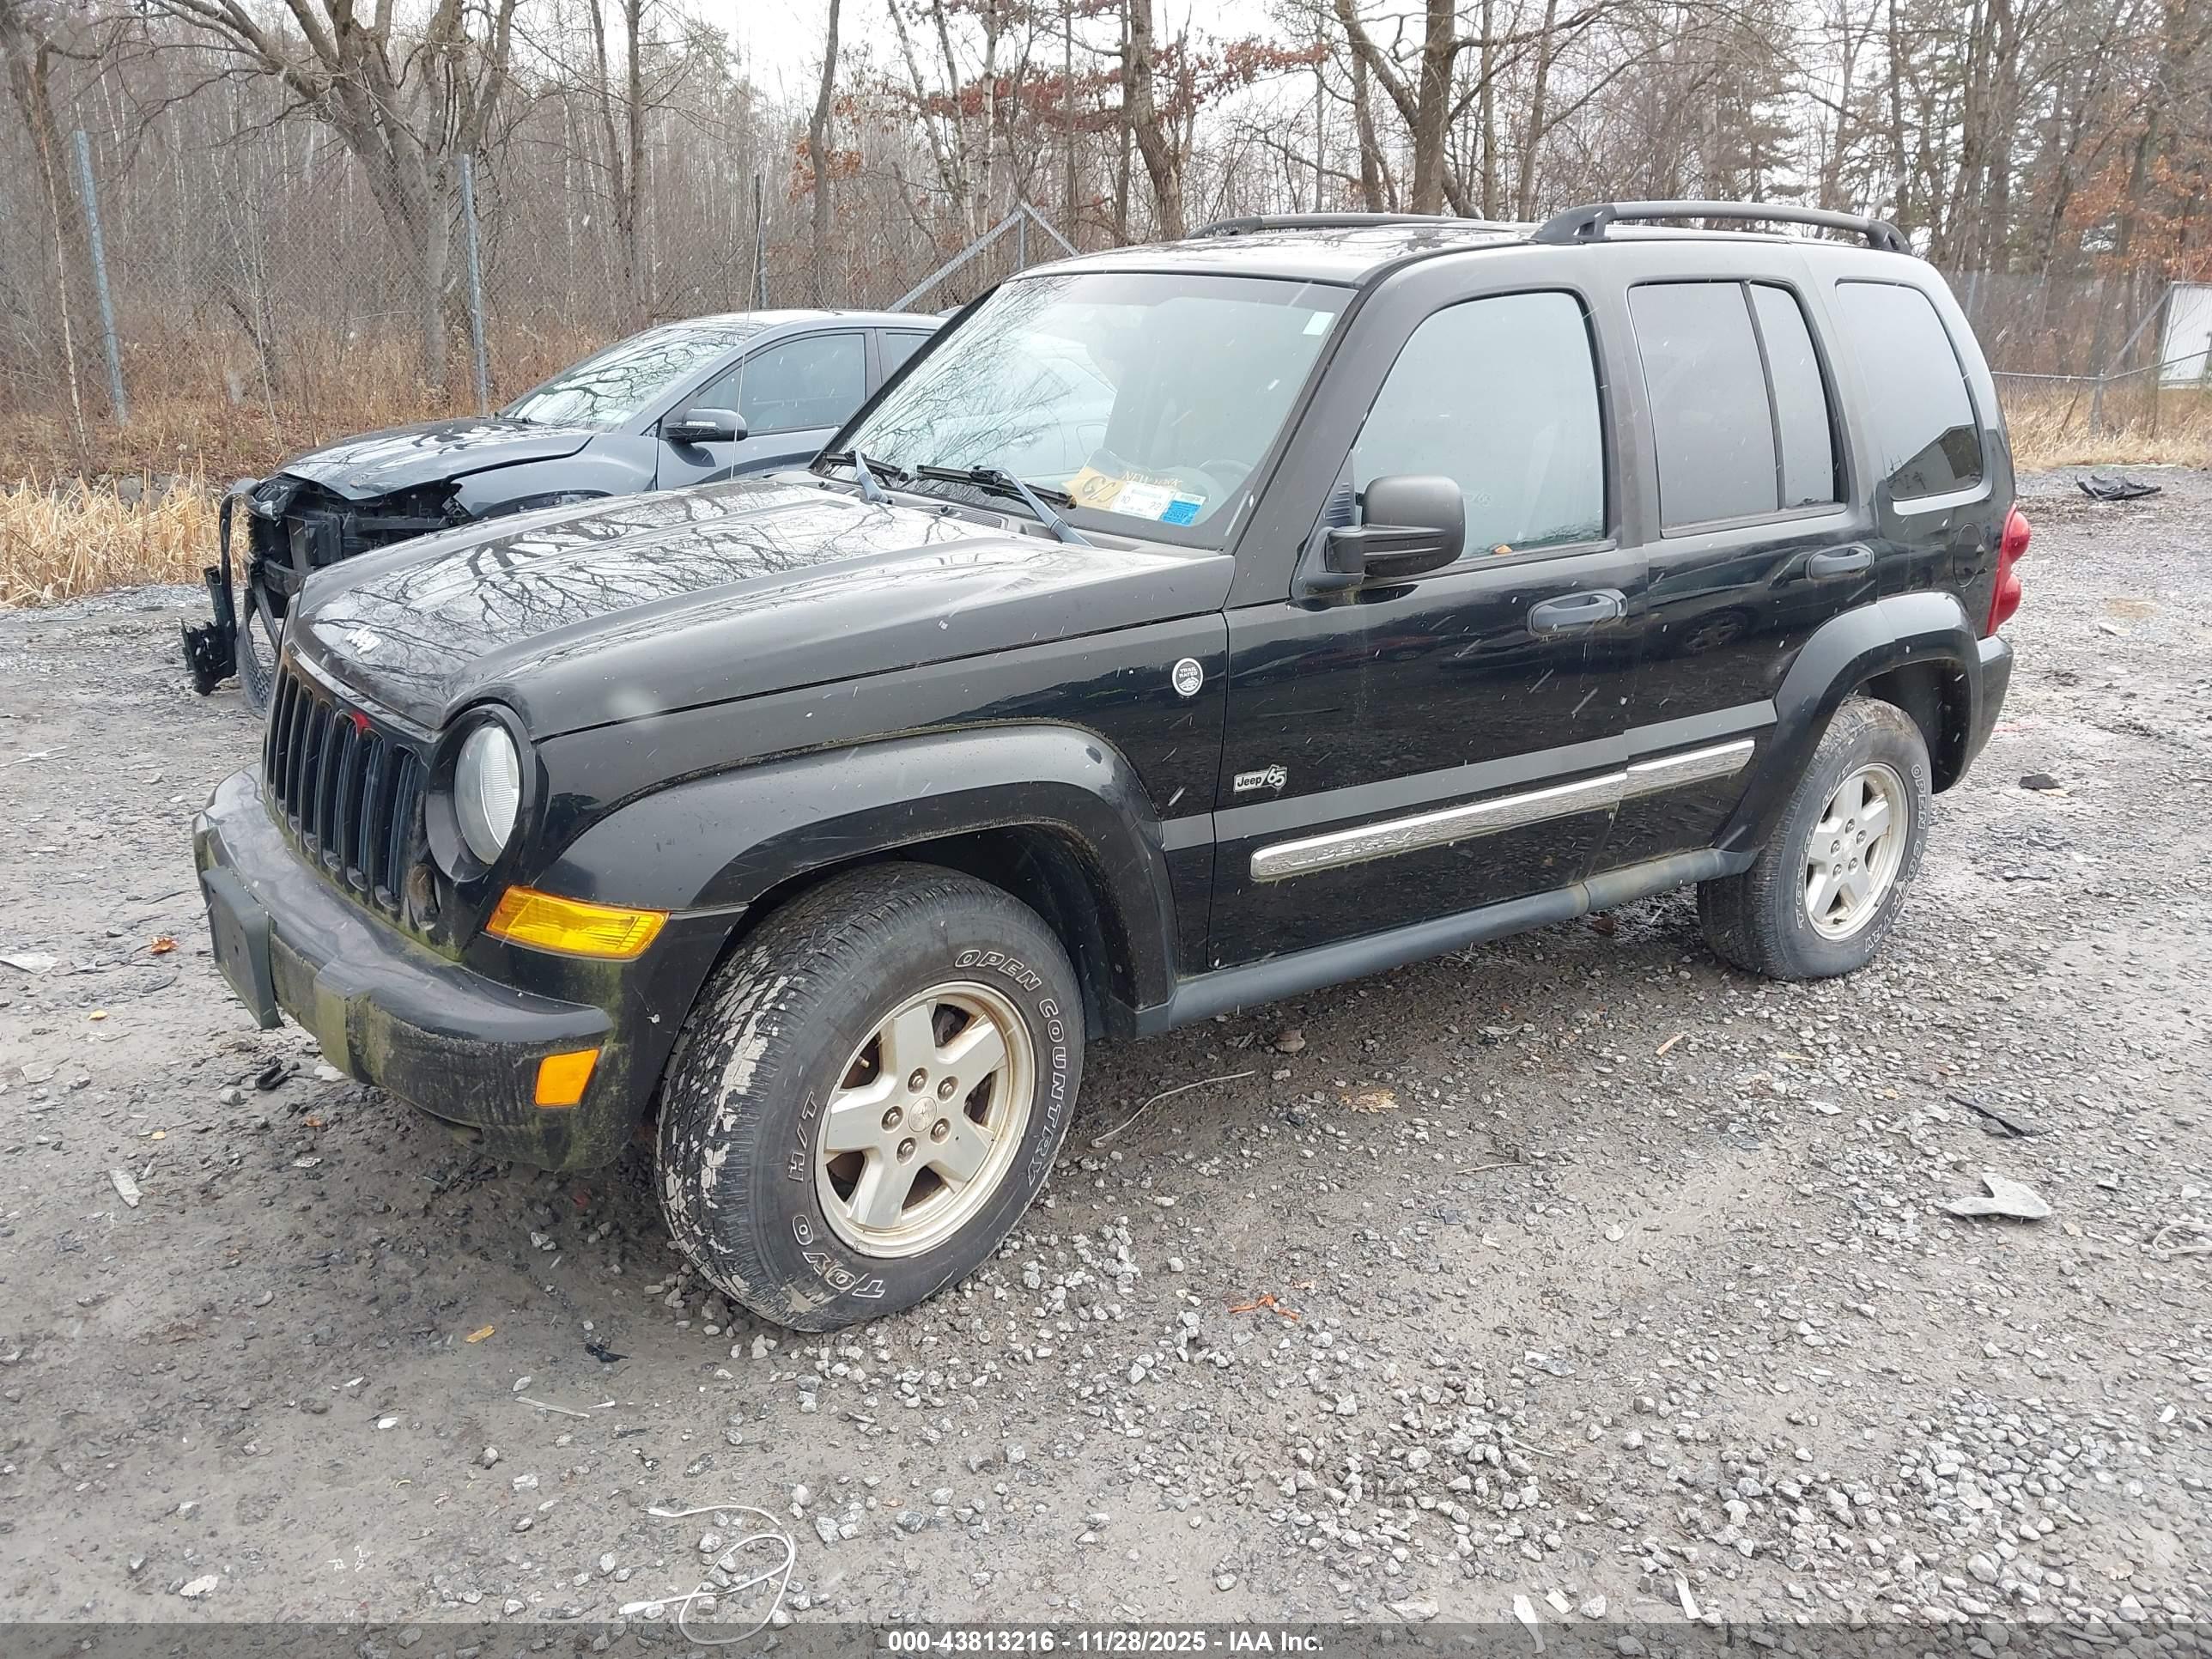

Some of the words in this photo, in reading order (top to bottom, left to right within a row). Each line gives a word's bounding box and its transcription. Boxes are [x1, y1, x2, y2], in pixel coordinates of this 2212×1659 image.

[345, 625, 382, 654] Jeep
[1237, 775, 1262, 787] Jeep
[1267, 768, 1285, 787] 65
[1911, 763, 1927, 830] OPEN
[1291, 828, 1413, 866] LIBERTY
[1795, 826, 1814, 928] TOYO
[1864, 841, 1923, 952] COUNTRY
[955, 949, 1042, 992] OPEN
[1027, 998, 1066, 1188] COUNTRY
[788, 1091, 817, 1182] H/T
[792, 1214, 885, 1298] TOYO
